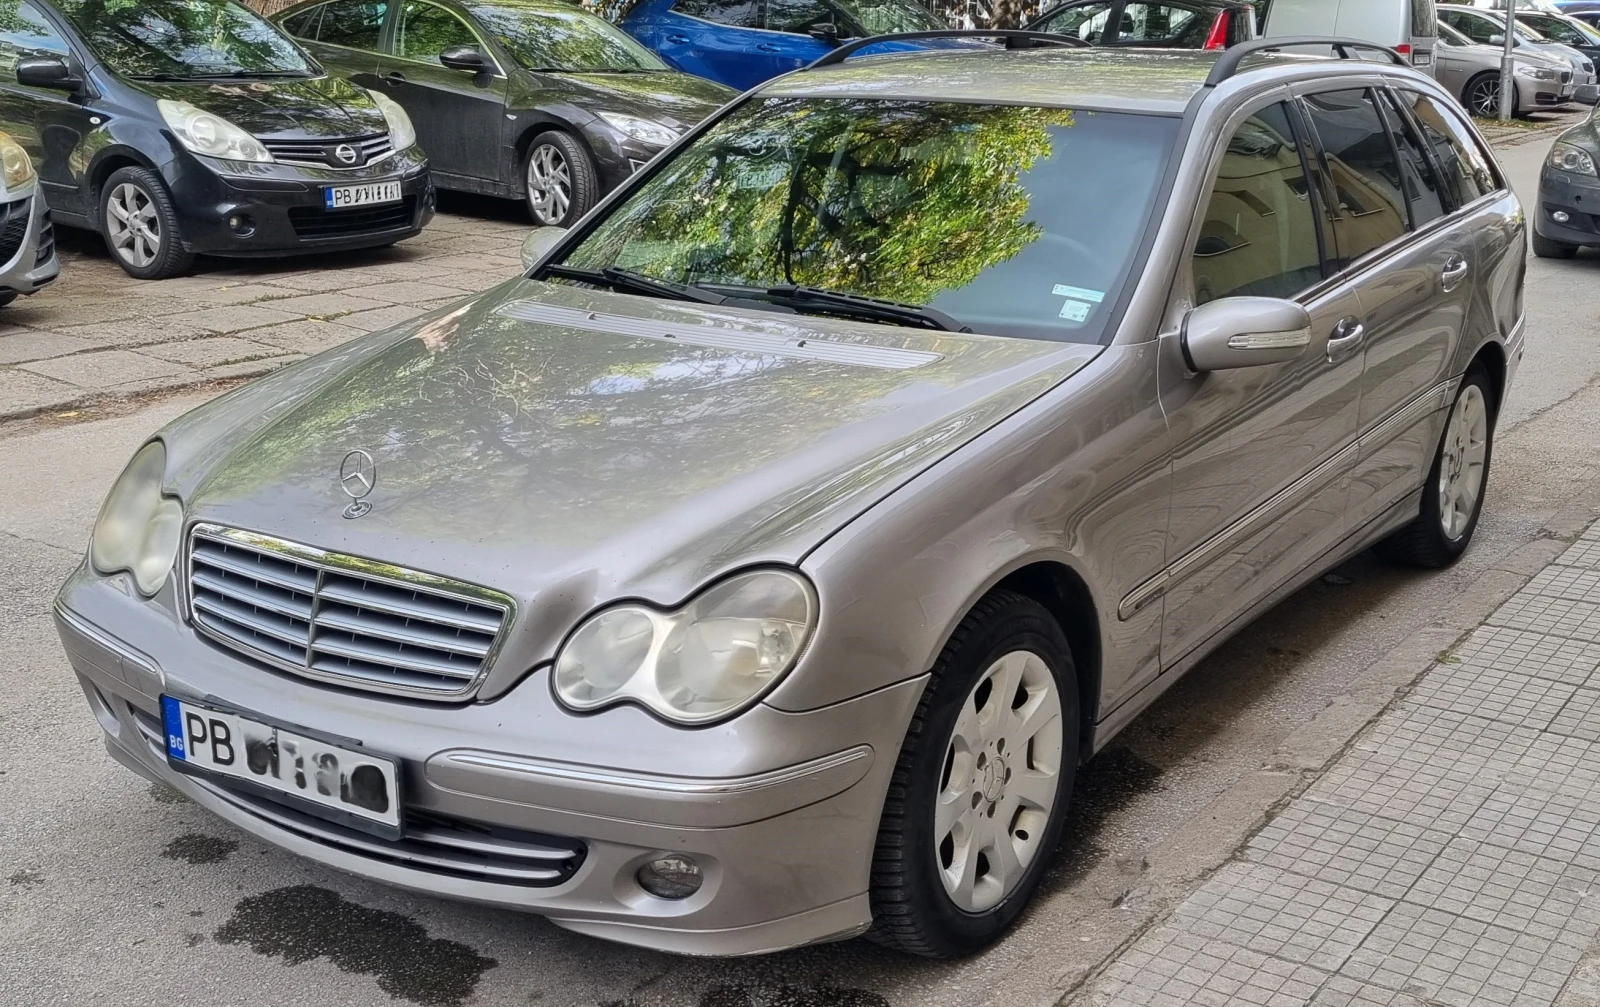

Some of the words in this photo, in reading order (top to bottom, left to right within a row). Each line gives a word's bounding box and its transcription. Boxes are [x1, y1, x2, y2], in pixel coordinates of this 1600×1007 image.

[335, 189, 352, 205] PB
[169, 734, 184, 751] BG
[185, 711, 235, 766] PB
